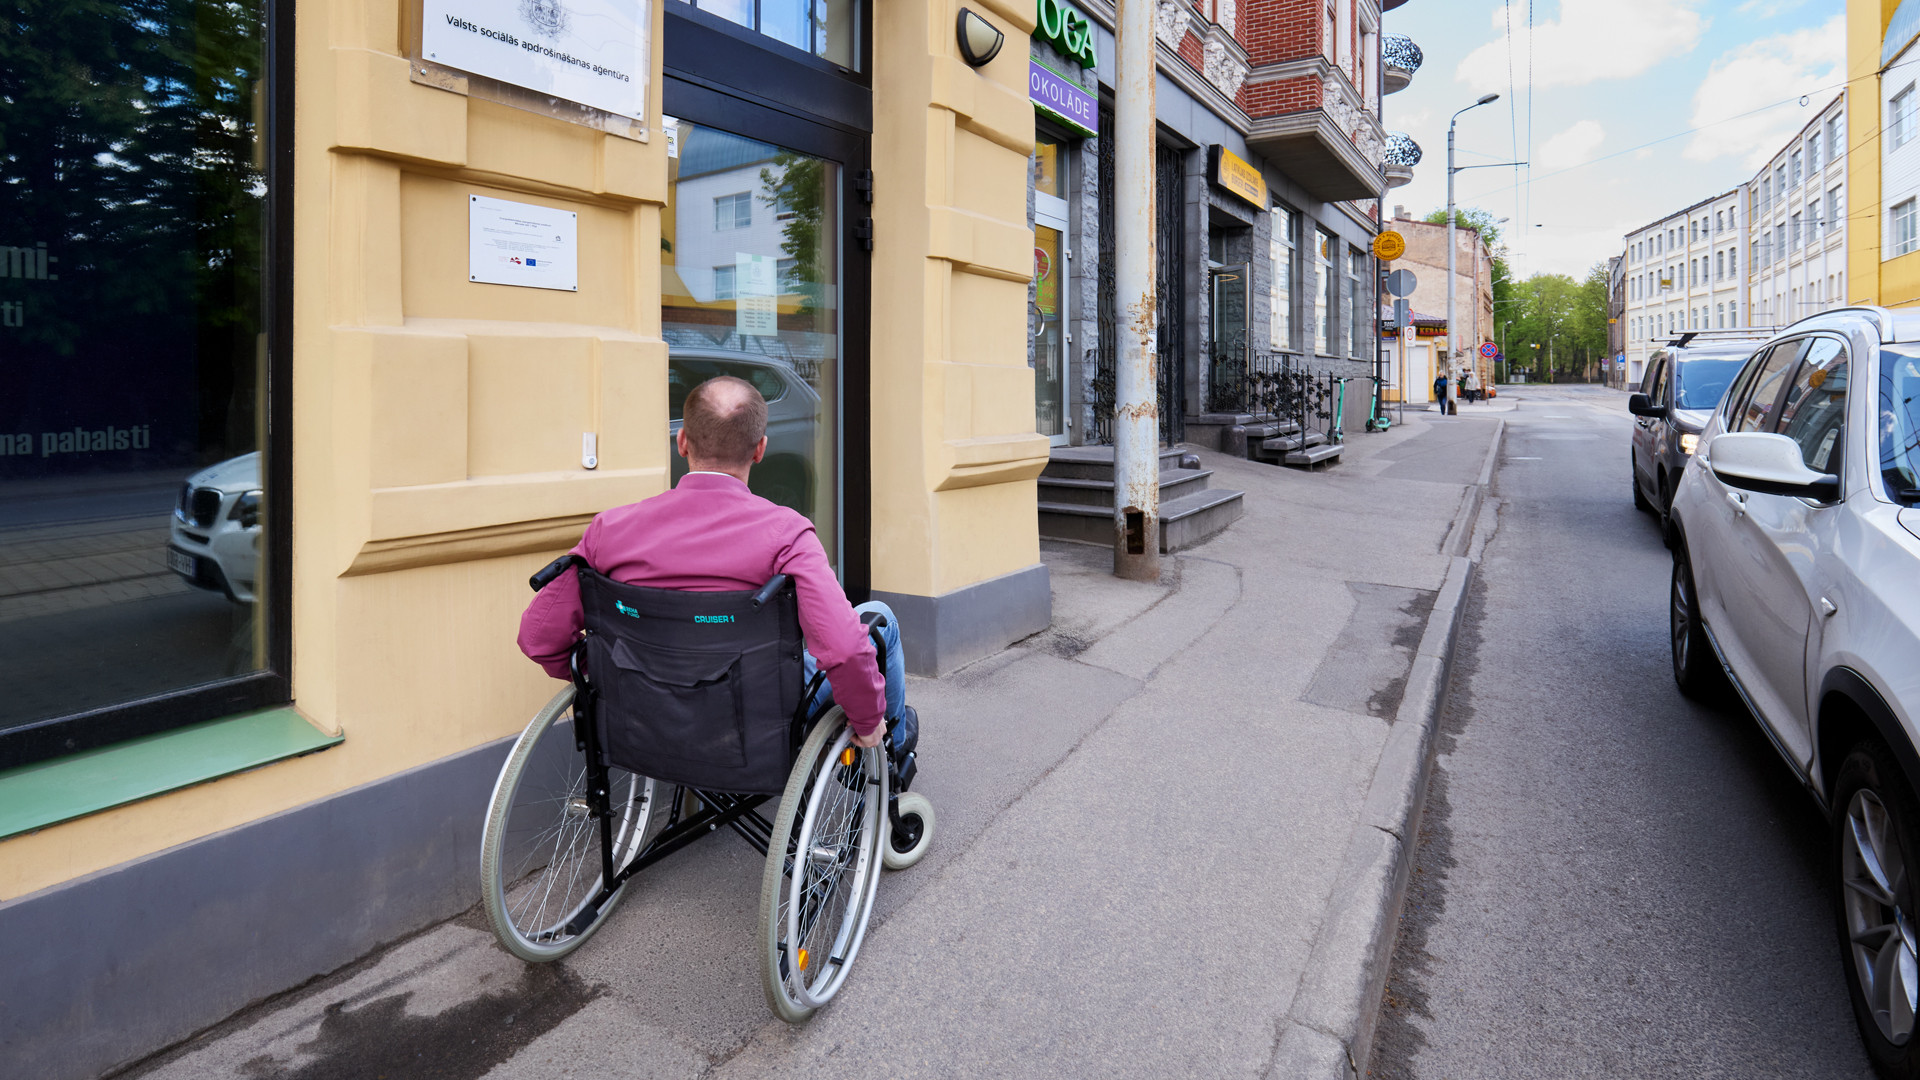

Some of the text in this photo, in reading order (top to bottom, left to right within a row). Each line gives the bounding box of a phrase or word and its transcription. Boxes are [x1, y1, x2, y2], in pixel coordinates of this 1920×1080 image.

[446, 14, 630, 83] Valsts sociālās apdrošināšanas aģentūra
[1031, 72, 1090, 120] OKOLĀDE
[0, 300, 24, 328] ti
[41, 424, 150, 458] pabalsti
[694, 615, 735, 624] CRUISER 1
